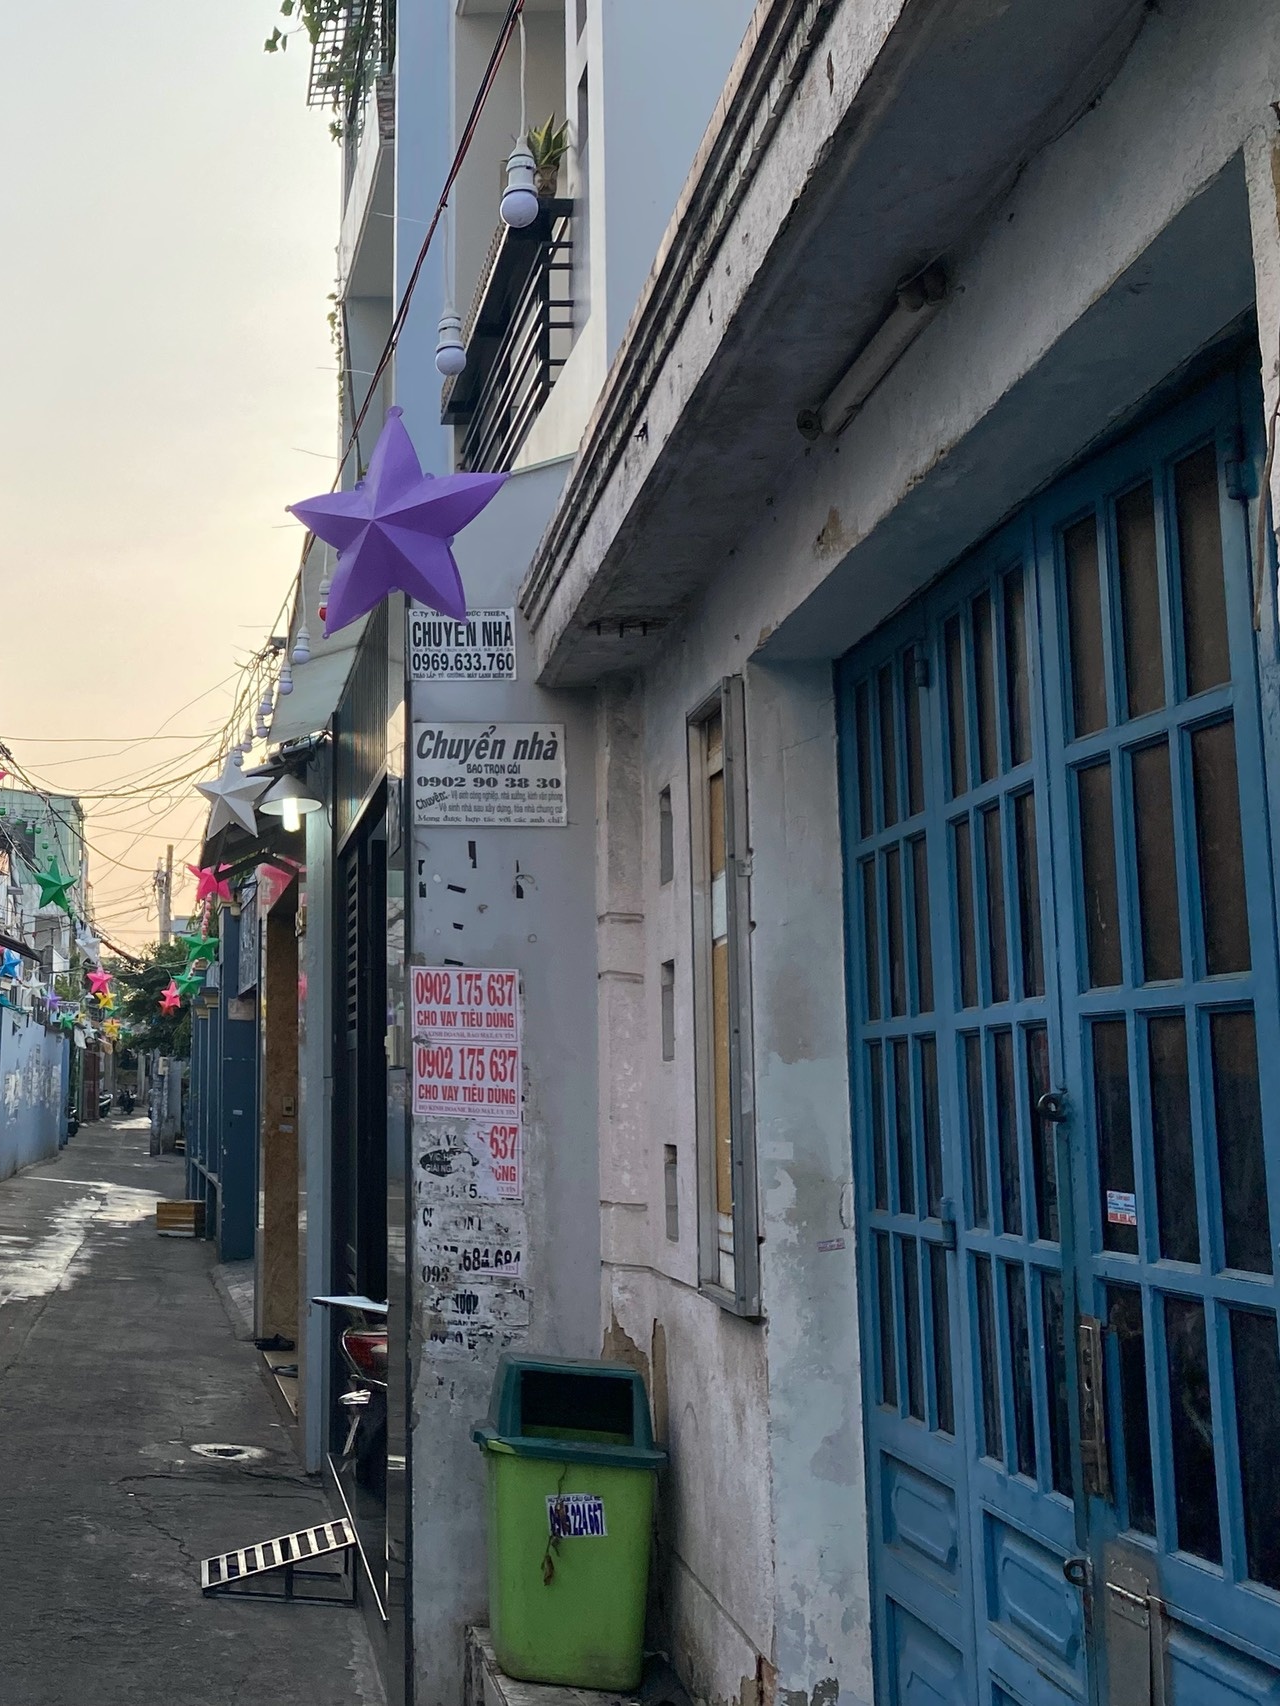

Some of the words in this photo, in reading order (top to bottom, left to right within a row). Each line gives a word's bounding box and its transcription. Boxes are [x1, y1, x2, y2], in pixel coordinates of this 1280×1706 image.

[482, 614, 514, 647] NHÀ
[412, 653, 515, 671] 0969.633.760
[417, 725, 506, 765] Chuyển
[513, 731, 559, 761] nhà
[466, 763, 483, 774] BAO
[484, 764, 506, 776] TRỌN
[507, 762, 521, 775] GÓI
[417, 776, 466, 788] 0902
[473, 777, 499, 788] 90
[536, 778, 561, 789] 30
[415, 971, 451, 1005] 0902
[456, 972, 483, 1006] 175
[487, 973, 515, 1006] 637
[417, 1010, 437, 1026] CHO
[440, 1011, 458, 1027] VAY
[461, 1008, 483, 1027] TIÊU
[486, 1008, 514, 1028] DÙNG
[418, 1046, 453, 1079] 0902
[459, 1047, 485, 1081] 175
[490, 1048, 517, 1082] 637
[418, 1084, 438, 1100] CHO
[442, 1085, 459, 1101] VAY
[462, 1084, 484, 1103] TIÊU
[487, 1084, 516, 1104] DÙNG
[490, 1125, 518, 1160] 637
